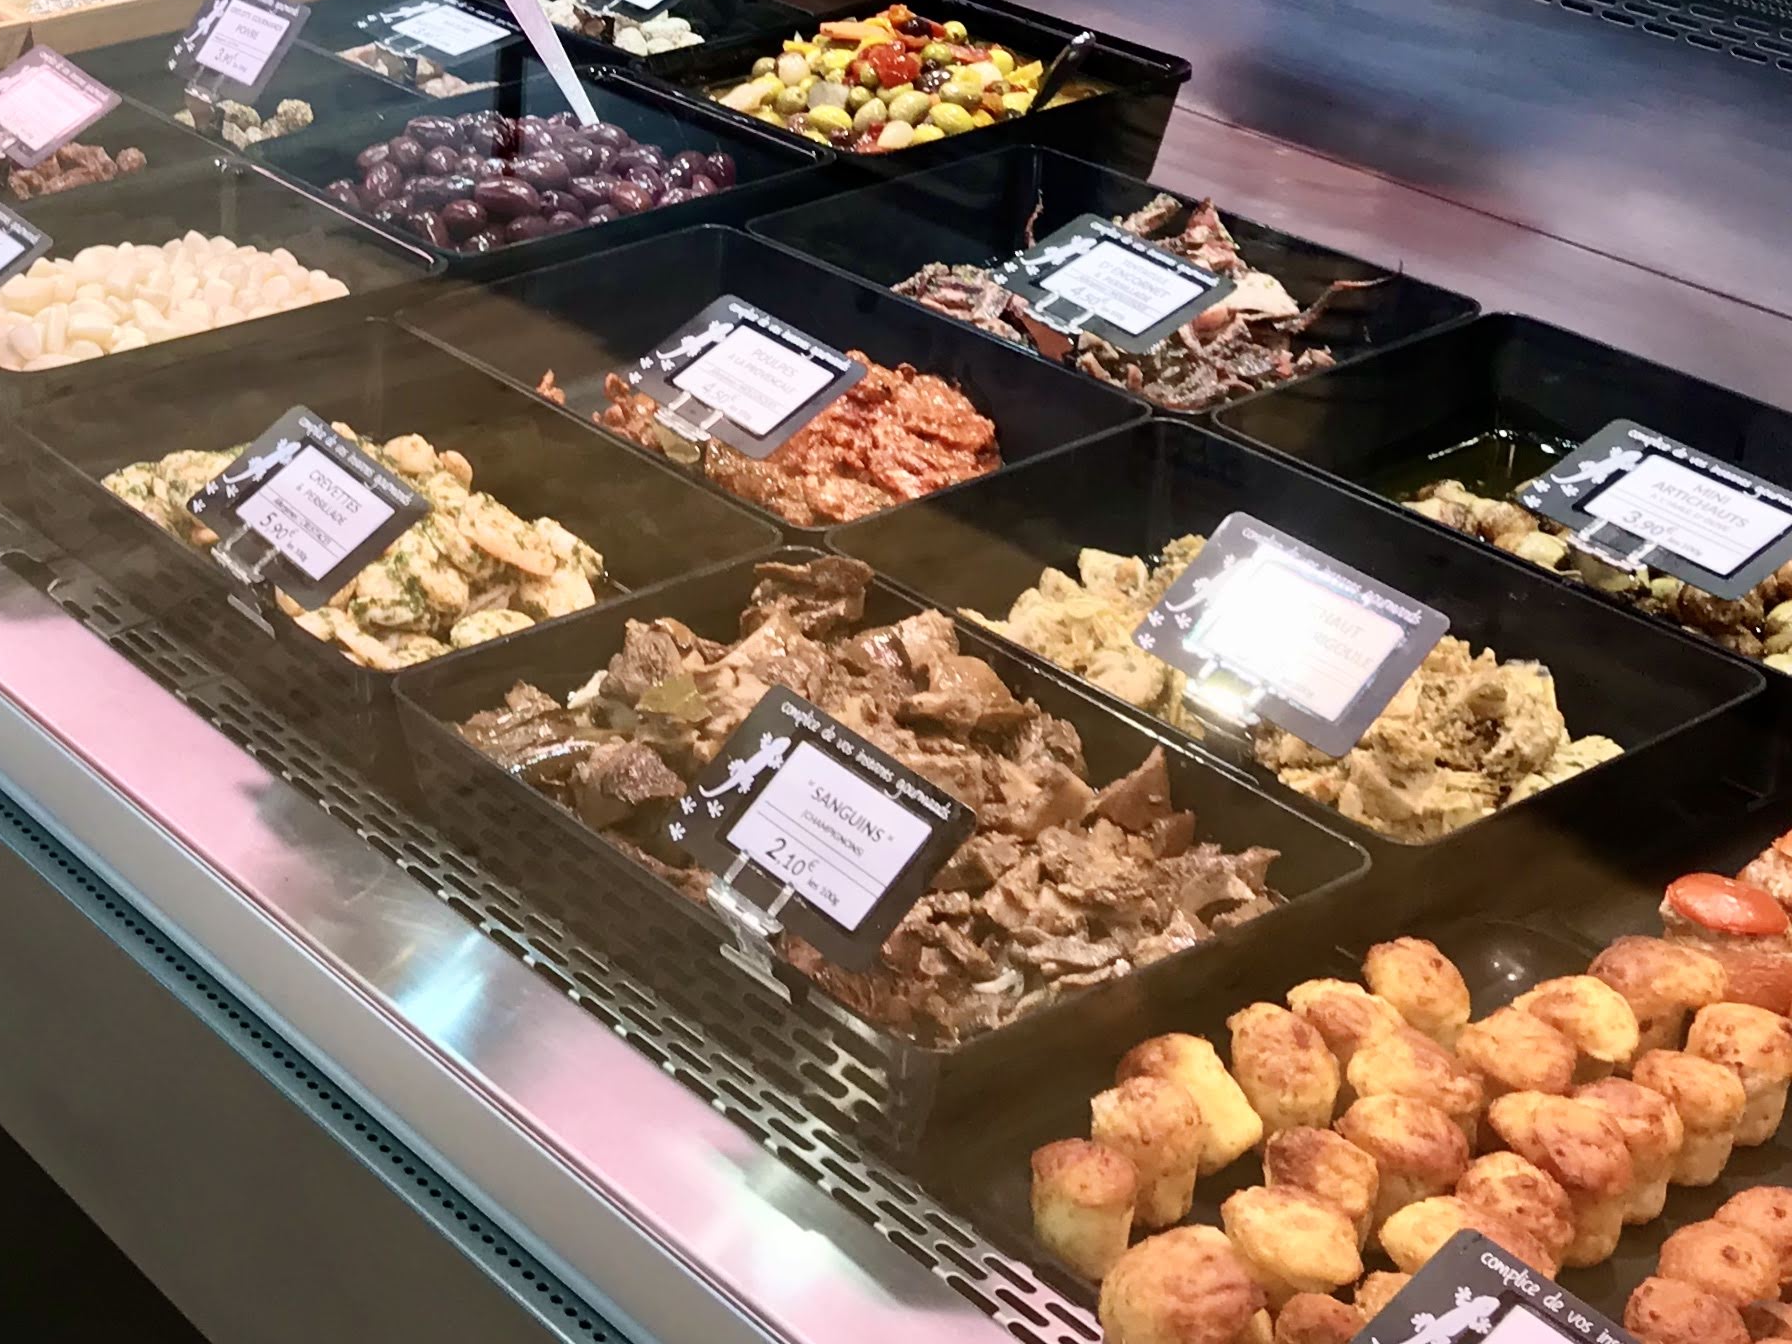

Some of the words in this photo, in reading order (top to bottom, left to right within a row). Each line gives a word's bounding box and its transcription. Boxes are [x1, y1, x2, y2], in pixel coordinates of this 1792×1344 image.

[751, 348, 798, 377] POULPES
[306, 490, 348, 527] PERSILLADE
[308, 469, 363, 514] CREVETTES
[1651, 481, 1749, 529] ARTICHAUTS
[1693, 484, 1733, 505] MINI
[810, 784, 887, 844] SANGUINS
[1480, 1252, 1541, 1297] complice
[1543, 1292, 1565, 1313] de
[1567, 1310, 1594, 1334] vos
